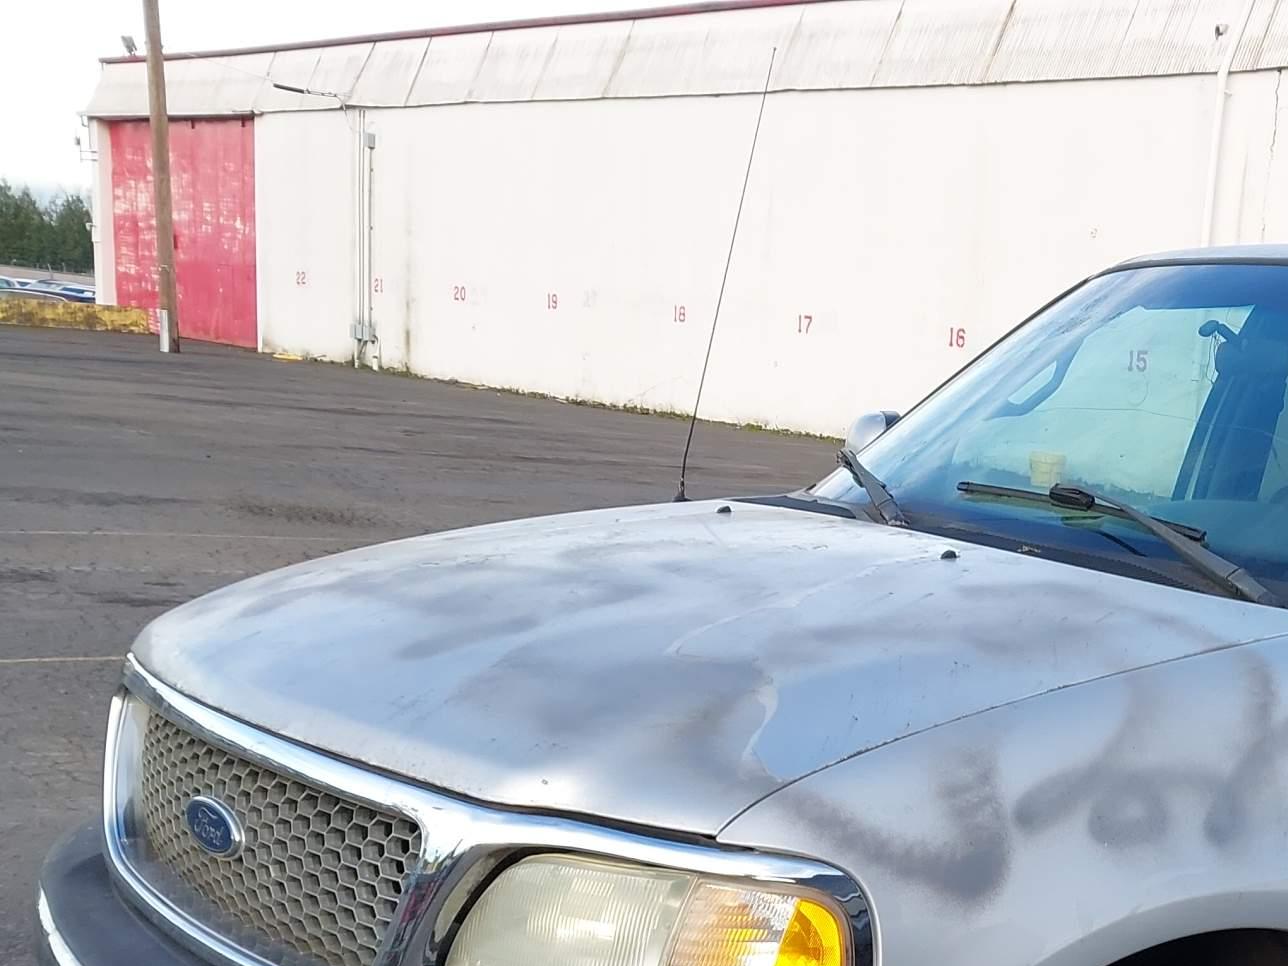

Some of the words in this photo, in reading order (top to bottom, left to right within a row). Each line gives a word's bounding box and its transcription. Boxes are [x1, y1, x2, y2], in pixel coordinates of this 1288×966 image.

[296, 271, 307, 285] 22
[373, 278, 384, 293] 21
[453, 286, 466, 301] 20
[547, 293, 558, 309] 19
[673, 305, 686, 323] 18
[798, 315, 813, 334] 17
[949, 327, 966, 348] 16
[1127, 350, 1149, 372] 15
